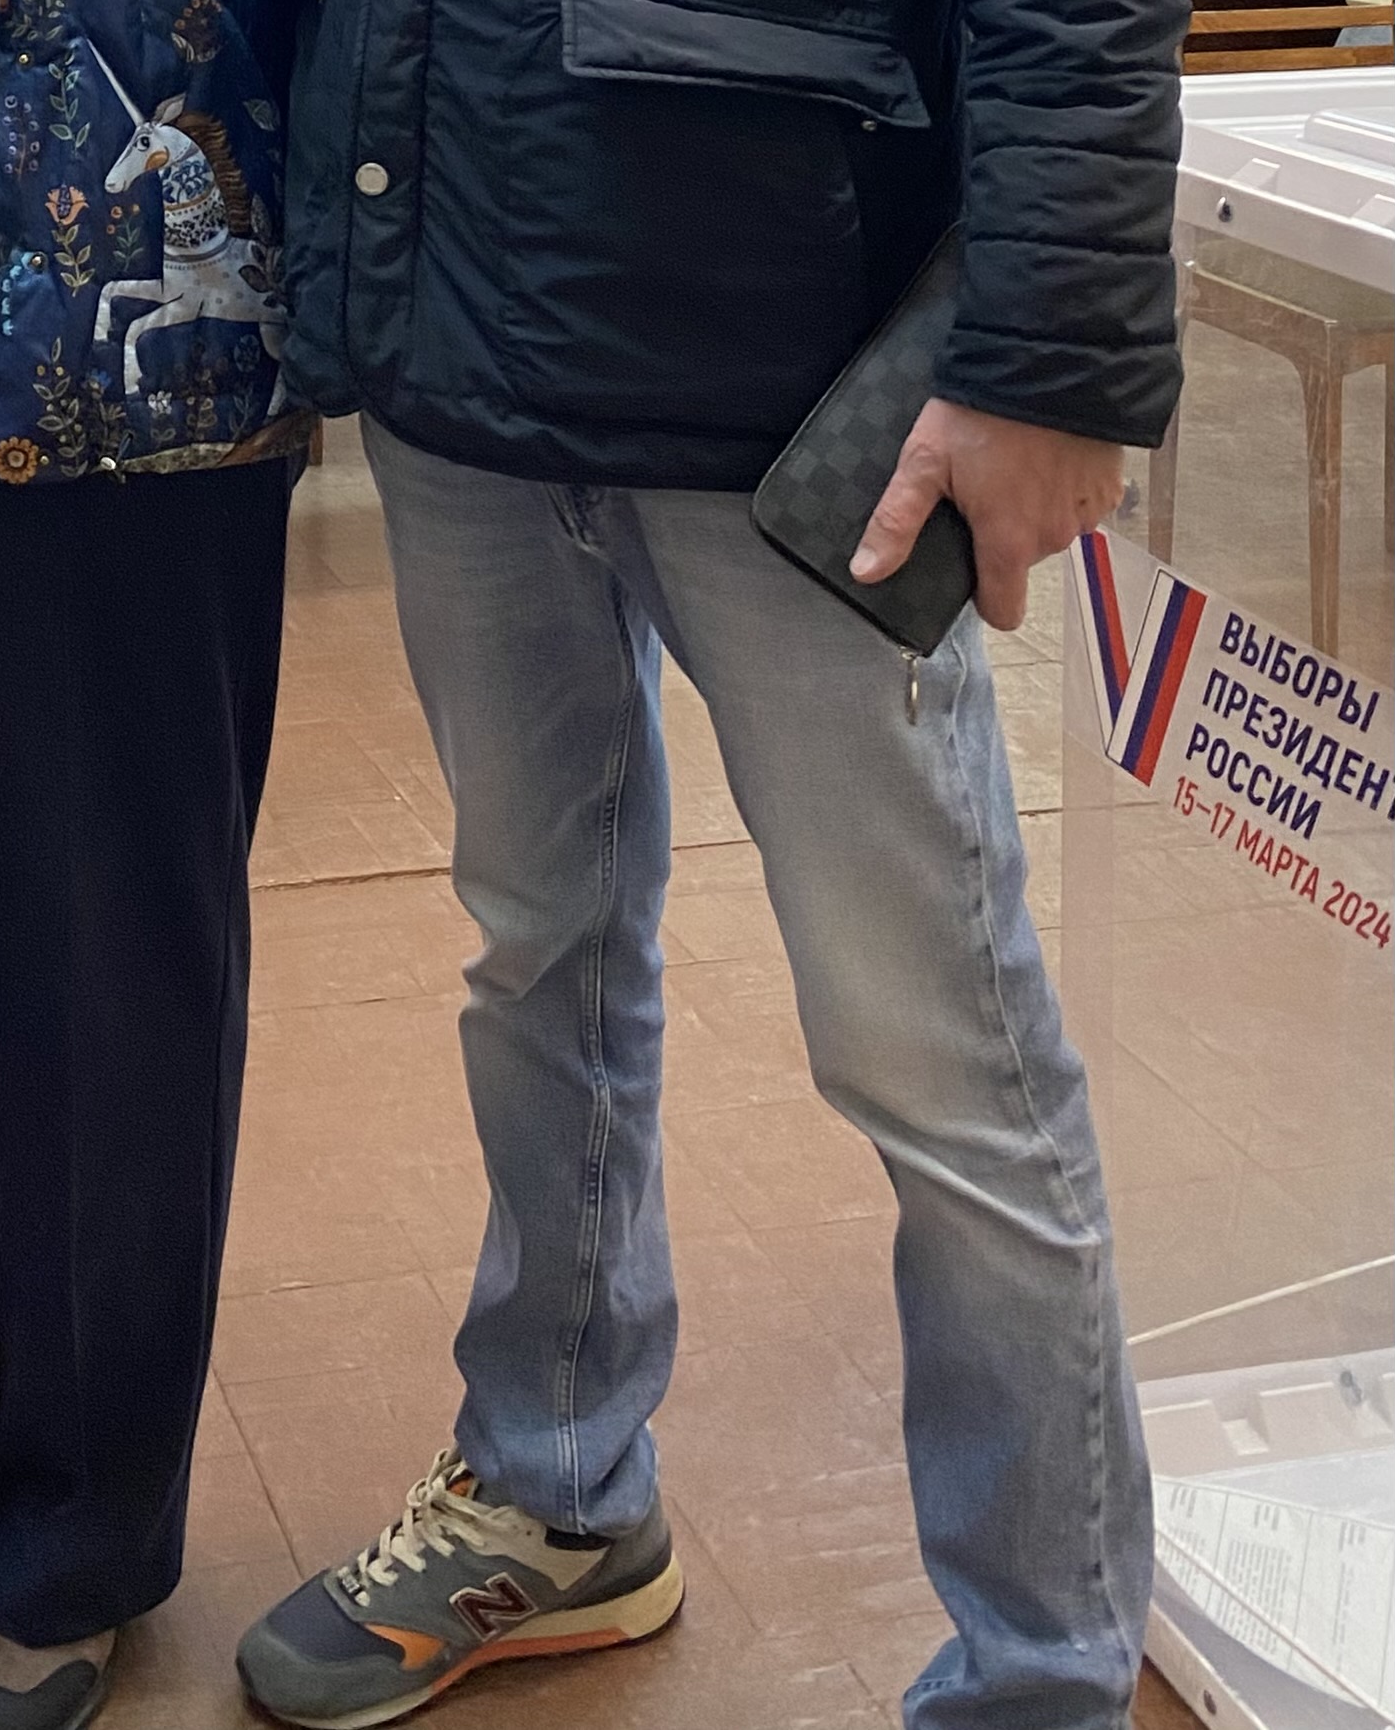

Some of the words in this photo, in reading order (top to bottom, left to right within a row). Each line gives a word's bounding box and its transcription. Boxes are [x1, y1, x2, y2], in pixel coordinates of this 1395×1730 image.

[1219, 611, 1380, 734] ВЫБОРЫ
[1185, 722, 1323, 840] РОССИИ
[1236, 819, 1320, 904] МАРТА
[1322, 880, 1392, 950] 2024
